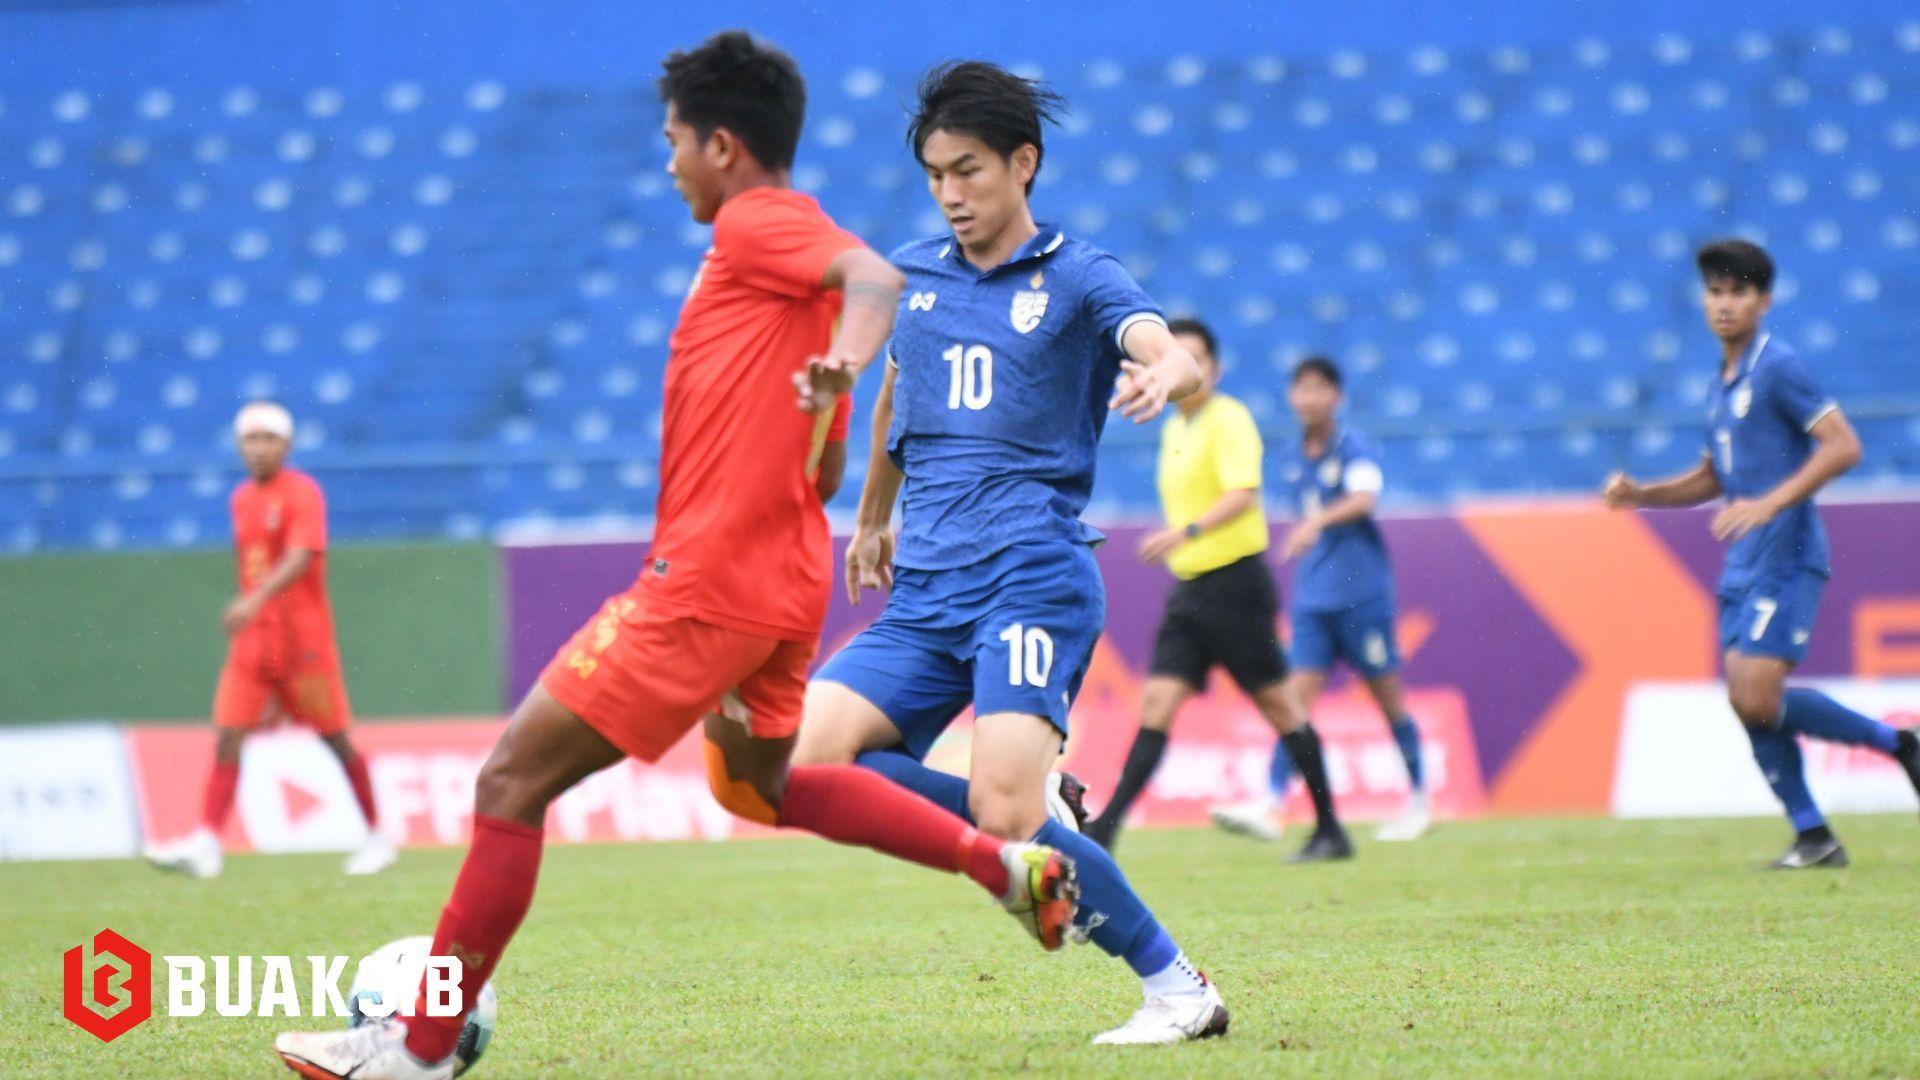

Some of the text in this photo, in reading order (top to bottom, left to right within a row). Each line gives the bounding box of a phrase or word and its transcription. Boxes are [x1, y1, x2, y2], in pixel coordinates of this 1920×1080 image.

[942, 343, 994, 411] 10
[1748, 597, 1778, 642] 7
[999, 623, 1054, 688] 10
[372, 750, 480, 845] FP
